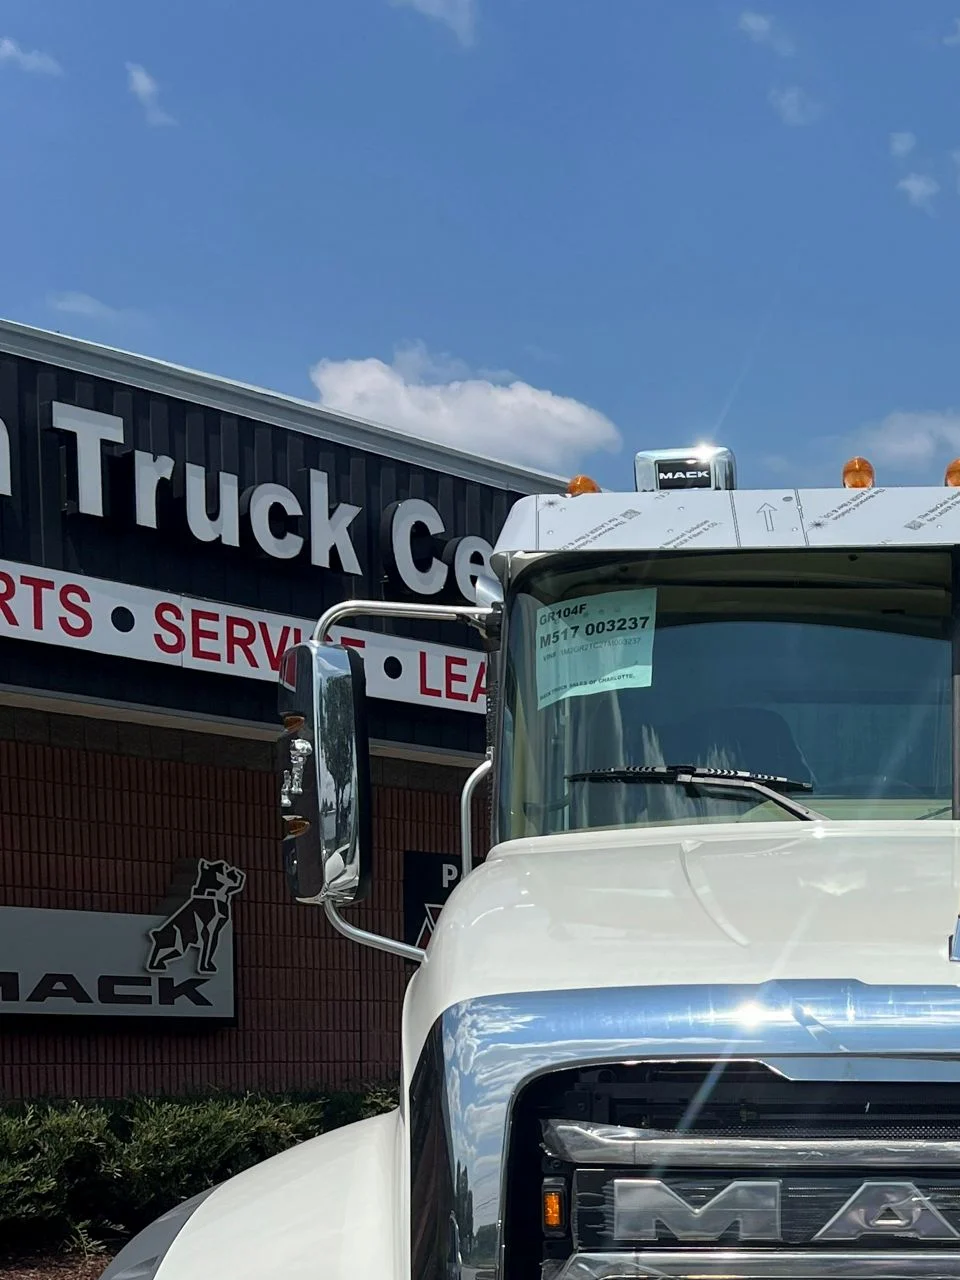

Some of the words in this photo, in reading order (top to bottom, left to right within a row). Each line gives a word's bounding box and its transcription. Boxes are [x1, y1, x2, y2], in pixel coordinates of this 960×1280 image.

[52, 401, 364, 576] Truck
[659, 470, 710, 480] MACK
[540, 603, 587, 626] GR104F
[154, 602, 365, 672] SERV
[540, 625, 580, 649] M517
[585, 616, 650, 636] 003237
